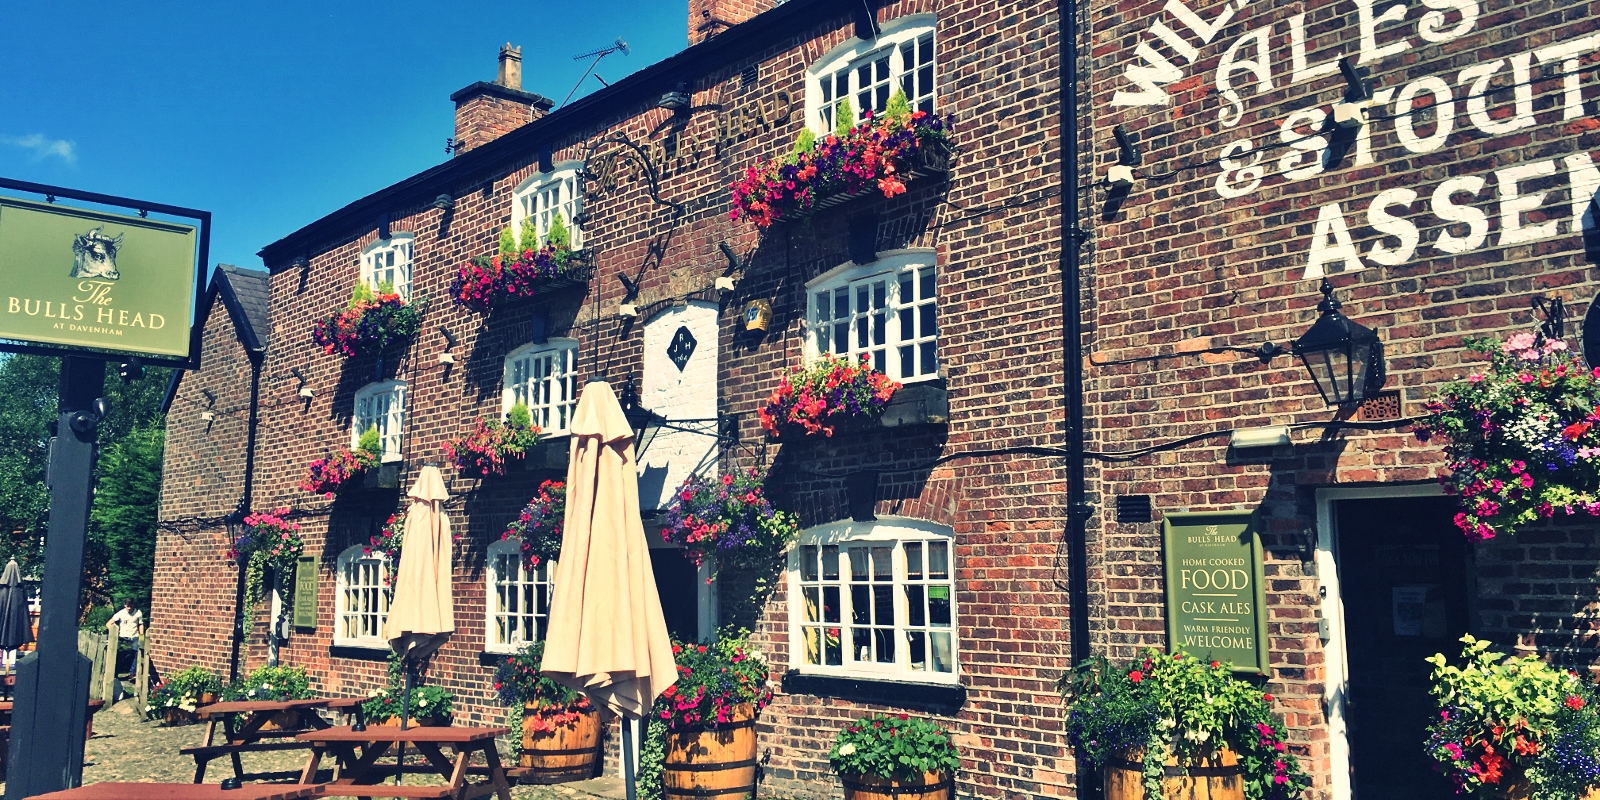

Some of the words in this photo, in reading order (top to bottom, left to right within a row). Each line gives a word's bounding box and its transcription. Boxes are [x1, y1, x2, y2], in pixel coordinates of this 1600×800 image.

[1110, 0, 1249, 106] WIL
[714, 89, 793, 145] HEAD
[1215, 138, 1264, 199] &
[72, 280, 115, 306] The
[8, 296, 84, 321] BULLS
[96, 307, 165, 330] HEAD
[54, 322, 65, 330] AT
[69, 324, 123, 336] DAVENHAM
[680, 334, 684, 342] R
[674, 345, 678, 353] J
[685, 342, 690, 350] H
[1204, 525, 1218, 536] The
[1187, 536, 1210, 544] BULLS
[1214, 535, 1237, 543] HEAD
[1182, 559, 1207, 567] HOME
[1209, 558, 1245, 566] COOKED
[1181, 569, 1249, 590] FOOD
[1181, 601, 1216, 614] CASK
[1220, 602, 1250, 615] ALES
[1183, 624, 1208, 633] WARM
[1211, 625, 1251, 635] FRIENDLY
[1184, 634, 1253, 650] WELCOME
